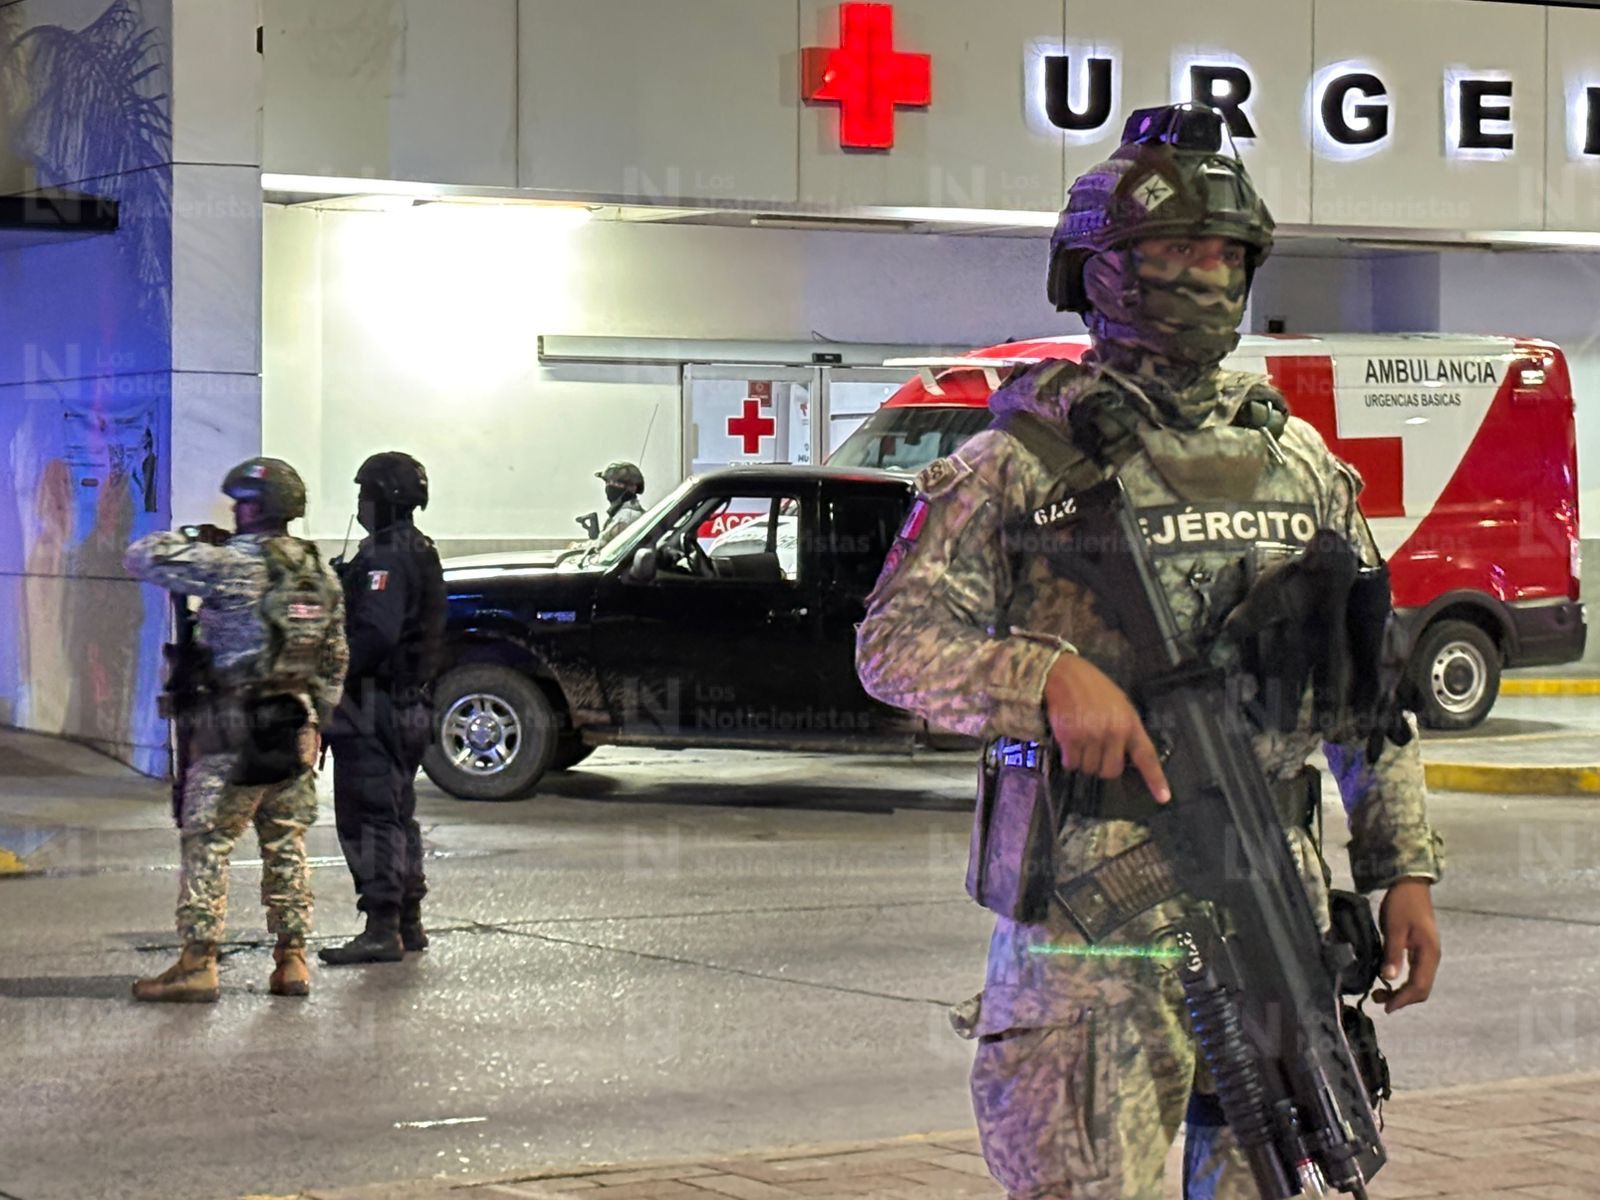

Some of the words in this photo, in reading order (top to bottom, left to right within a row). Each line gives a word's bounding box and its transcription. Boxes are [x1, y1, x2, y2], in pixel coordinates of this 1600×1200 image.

[1044, 56, 1600, 155] URGE
[1365, 358, 1497, 384] AMBULANCIA
[1364, 393, 1419, 408] URGENCIAS
[1421, 393, 1462, 407] BASICAS
